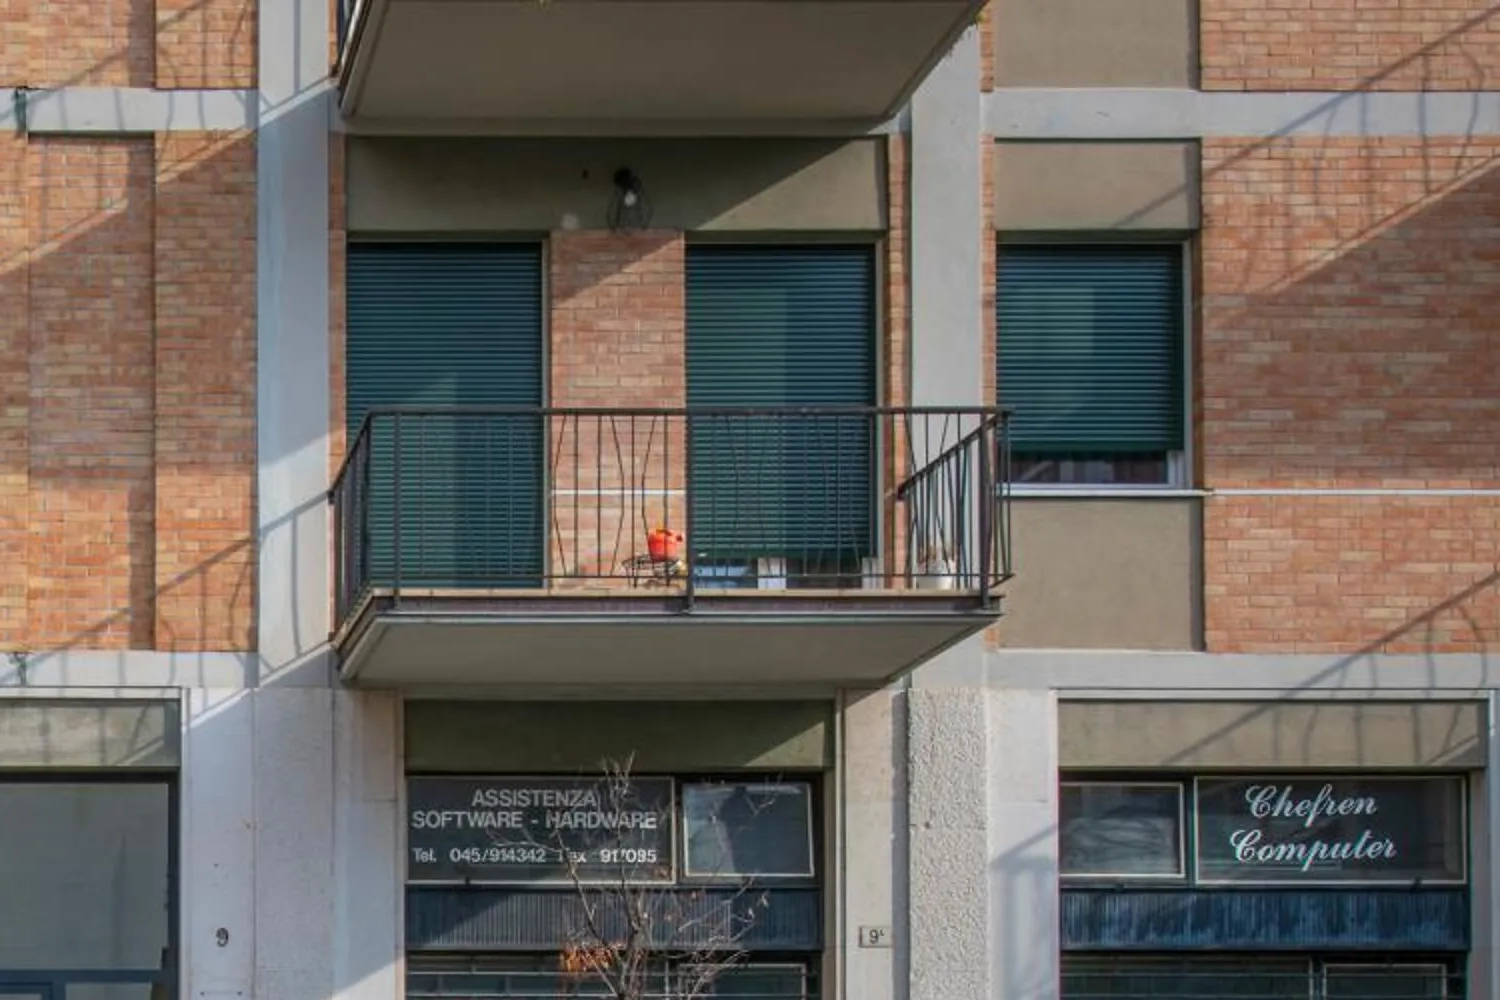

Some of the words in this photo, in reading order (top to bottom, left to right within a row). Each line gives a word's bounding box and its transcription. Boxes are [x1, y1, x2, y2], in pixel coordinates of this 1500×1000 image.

[471, 788, 598, 808] ASSISTENZA
[1245, 783, 1377, 828] Chefren
[411, 811, 523, 829] SOFTWARE
[545, 811, 657, 829] HARDWARE
[412, 848, 438, 863] Tel.
[1229, 829, 1397, 872] Computer
[216, 927, 229, 948] 9
